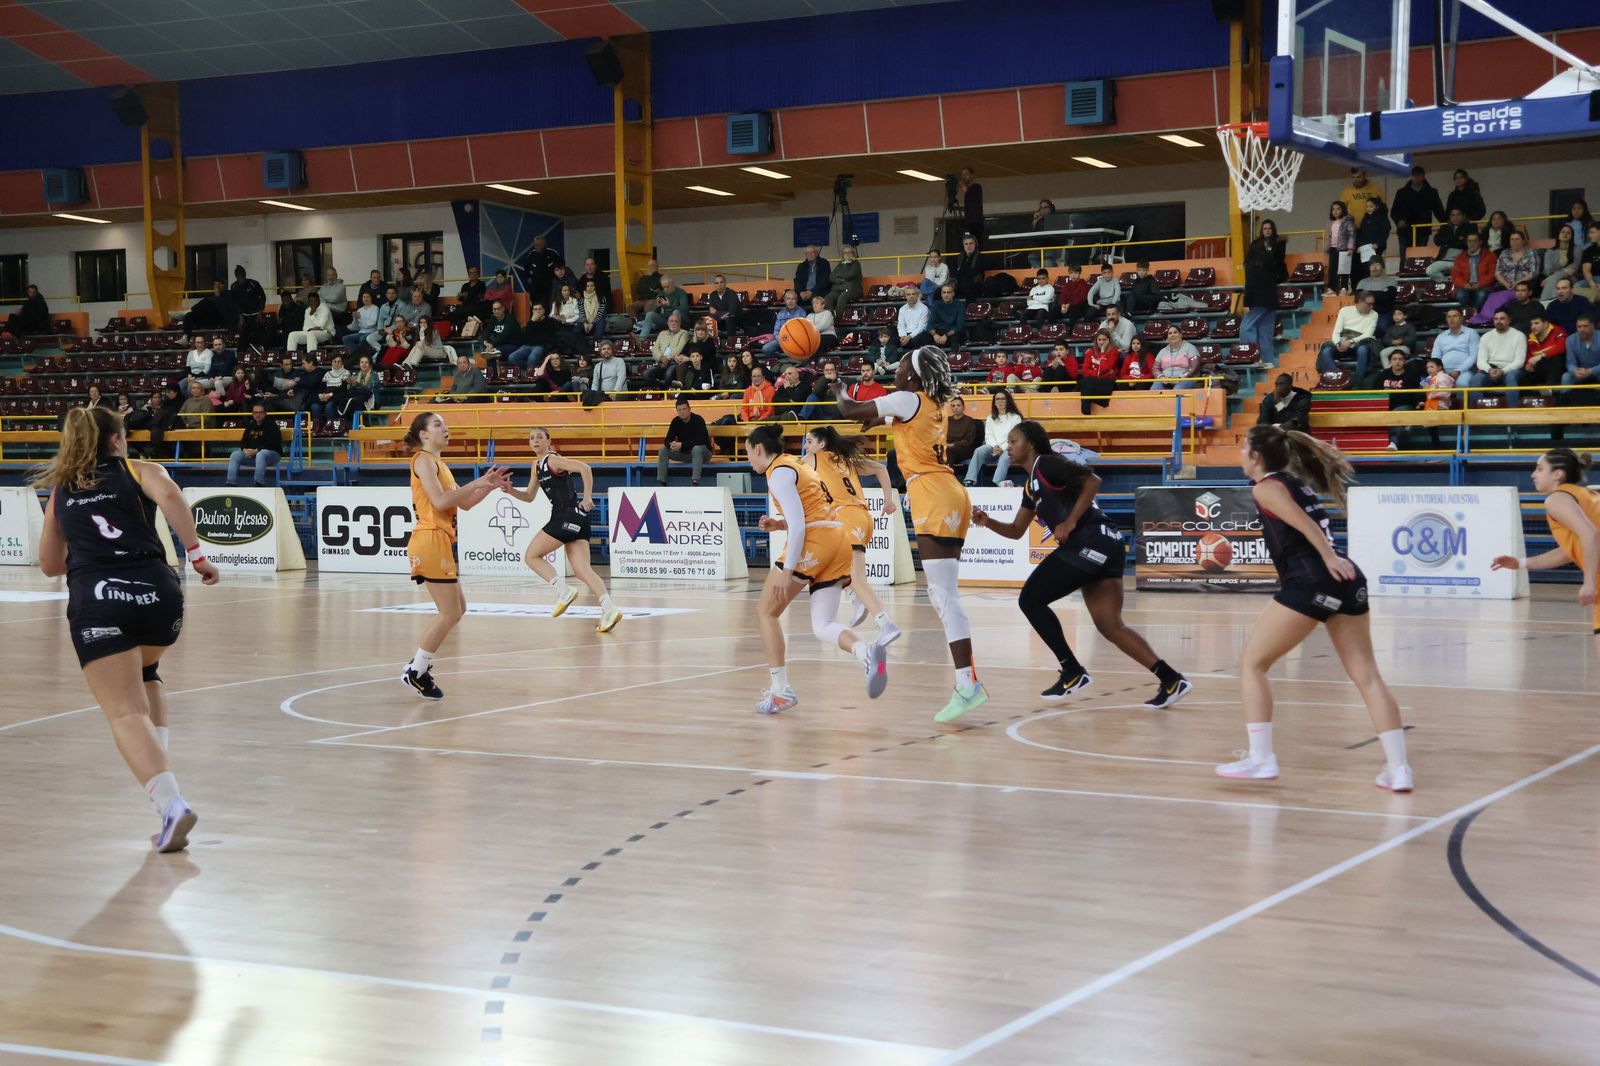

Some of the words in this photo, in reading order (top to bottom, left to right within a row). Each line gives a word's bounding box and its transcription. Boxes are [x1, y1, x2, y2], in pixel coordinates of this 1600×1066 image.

[1442, 105, 1522, 124] Schelde
[1442, 119, 1522, 138] Sports
[865, 498, 886, 511] ELIP
[195, 507, 231, 529] Paulino
[234, 507, 268, 531] Iglesias
[873, 517, 889, 530] MEZ
[1142, 519, 1264, 531] DORCOLCHÓ
[321, 504, 413, 556] G3C
[7, 537, 23, 547] S.L.
[866, 537, 890, 549] RERO
[1392, 525, 1467, 556] C&M
[0, 549, 24, 557] ONES
[321, 547, 351, 556] GIMNASIO
[383, 549, 408, 557] CRUCE
[464, 547, 521, 562] recoletas
[1030, 551, 1049, 560] Rep
[1146, 541, 1197, 557] COMPITE
[205, 552, 275, 567] paulinoiglesias.com
[626, 566, 638, 574] 980
[649, 567, 658, 575] 85
[659, 567, 668, 575] 90
[673, 567, 686, 575] 605
[687, 567, 696, 575] 76
[707, 568, 716, 576] 05
[866, 563, 890, 578] GADO
